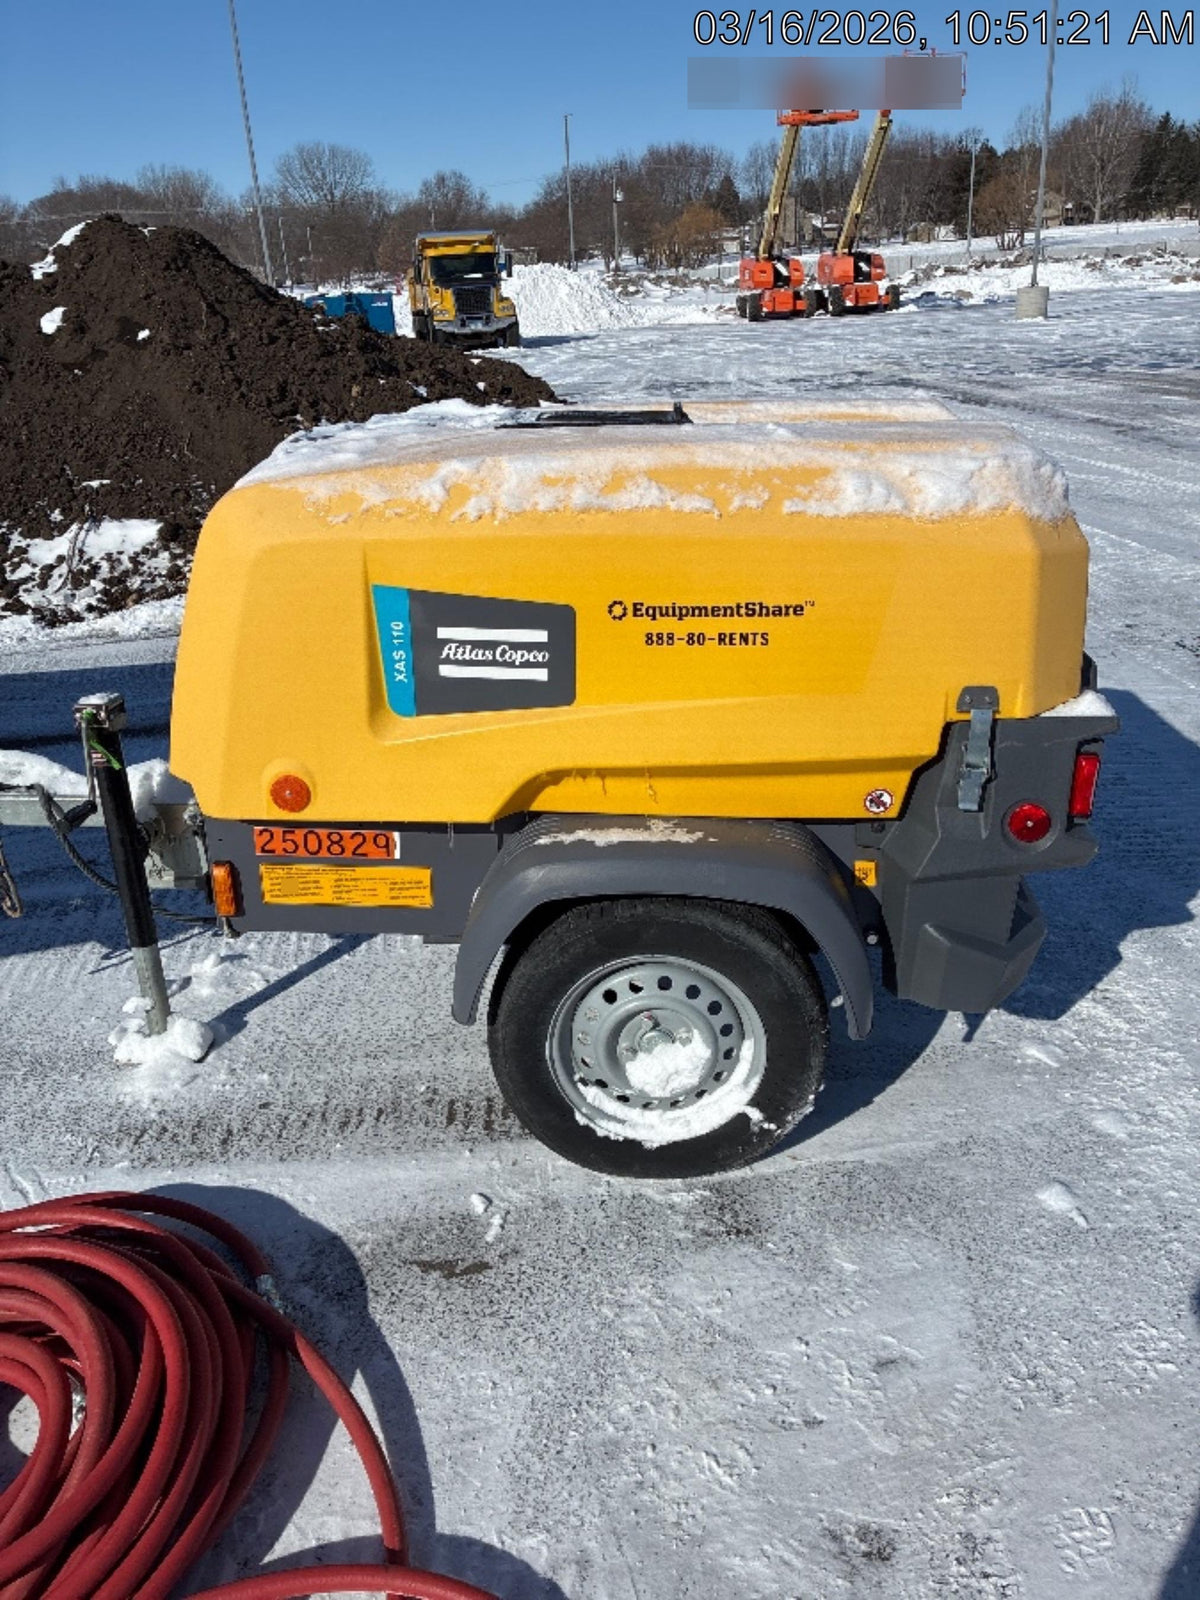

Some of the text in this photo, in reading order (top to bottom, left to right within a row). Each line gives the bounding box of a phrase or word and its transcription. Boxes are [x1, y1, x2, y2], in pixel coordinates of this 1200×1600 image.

[390, 621, 408, 683] XAS 110
[645, 632, 769, 646] 888-80-RENTS
[440, 643, 549, 665] Atlas Copco
[258, 828, 391, 858] 250829
